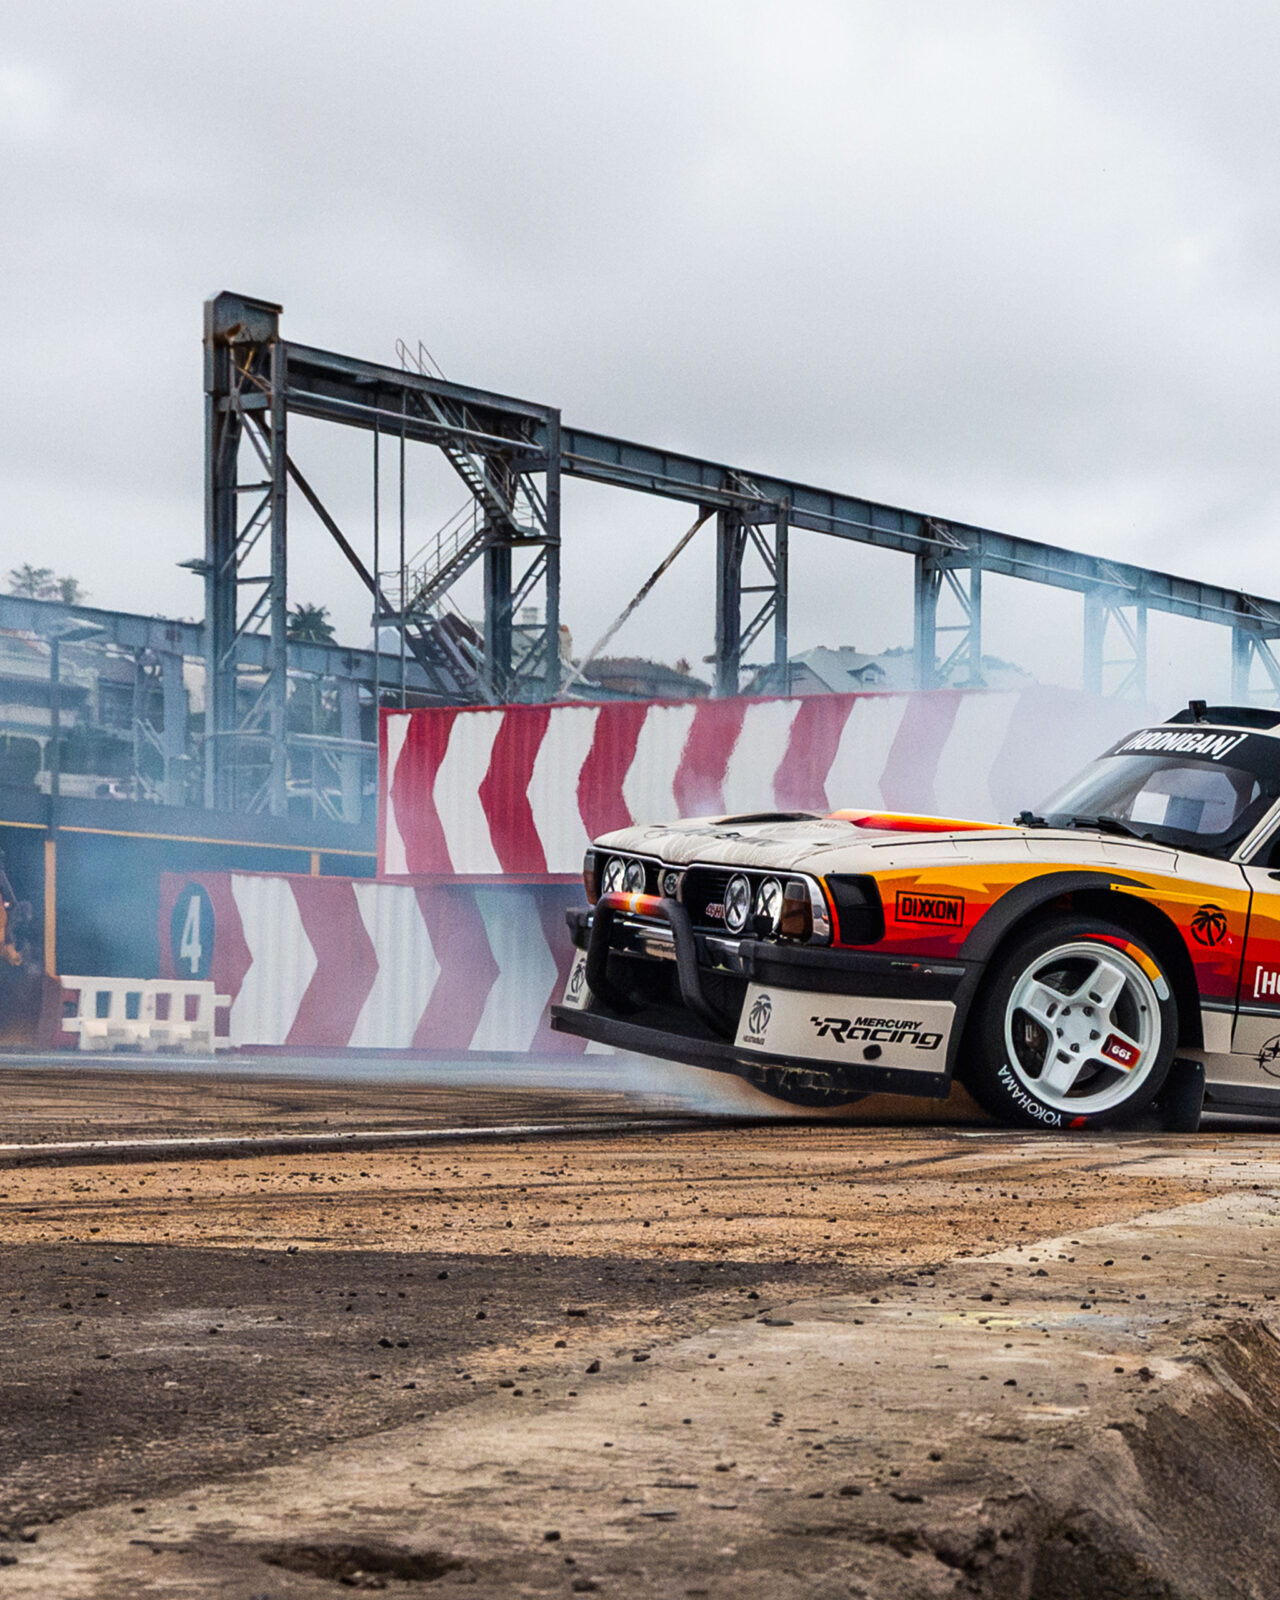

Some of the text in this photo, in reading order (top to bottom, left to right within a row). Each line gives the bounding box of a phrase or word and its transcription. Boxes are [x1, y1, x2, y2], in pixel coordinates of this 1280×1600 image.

[902, 896, 958, 922] DIXXON
[181, 895, 202, 974] 4
[816, 1017, 944, 1050] Racing
[854, 1017, 922, 1030] MERCURY
[1111, 1044, 1132, 1061] 199
[997, 1064, 1062, 1127] YOKOHAMA
